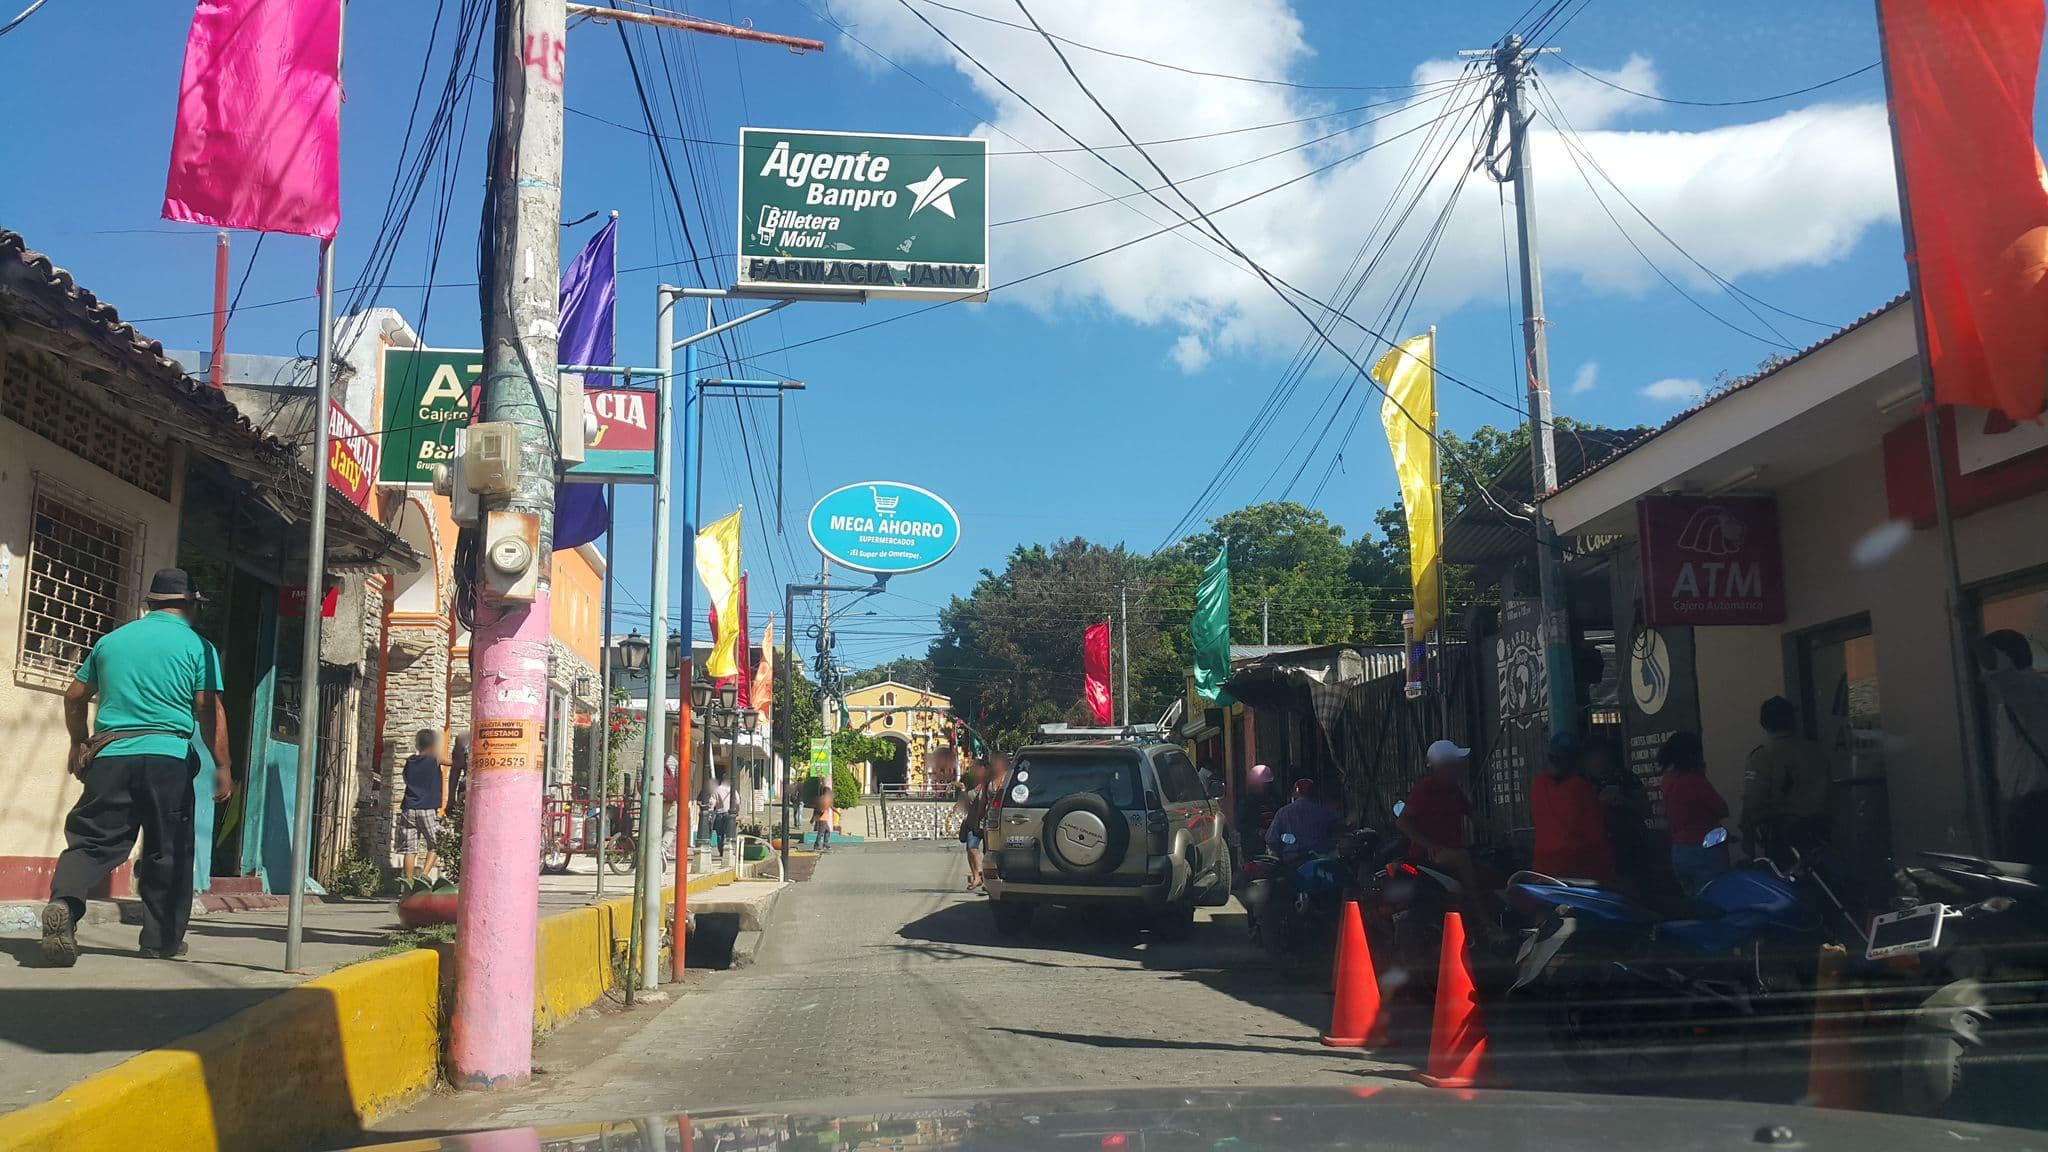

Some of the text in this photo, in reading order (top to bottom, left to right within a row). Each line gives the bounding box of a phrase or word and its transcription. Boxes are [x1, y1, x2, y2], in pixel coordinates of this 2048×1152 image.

[760, 141, 890, 188] Agente
[806, 183, 897, 211] Banpro
[766, 207, 840, 231] Billetera
[779, 230, 826, 248] Móvil
[750, 258, 977, 287] FARMACIA JANY
[418, 407, 468, 422] Cajero
[328, 404, 373, 487] ARMACIA
[331, 440, 362, 492] Jany
[830, 515, 944, 538] MEGA AHORRO
[859, 535, 915, 546] SUPERMERCADOS
[859, 550, 878, 558] Super
[1671, 562, 1762, 598] ATM
[1673, 600, 1705, 613] Cajero
